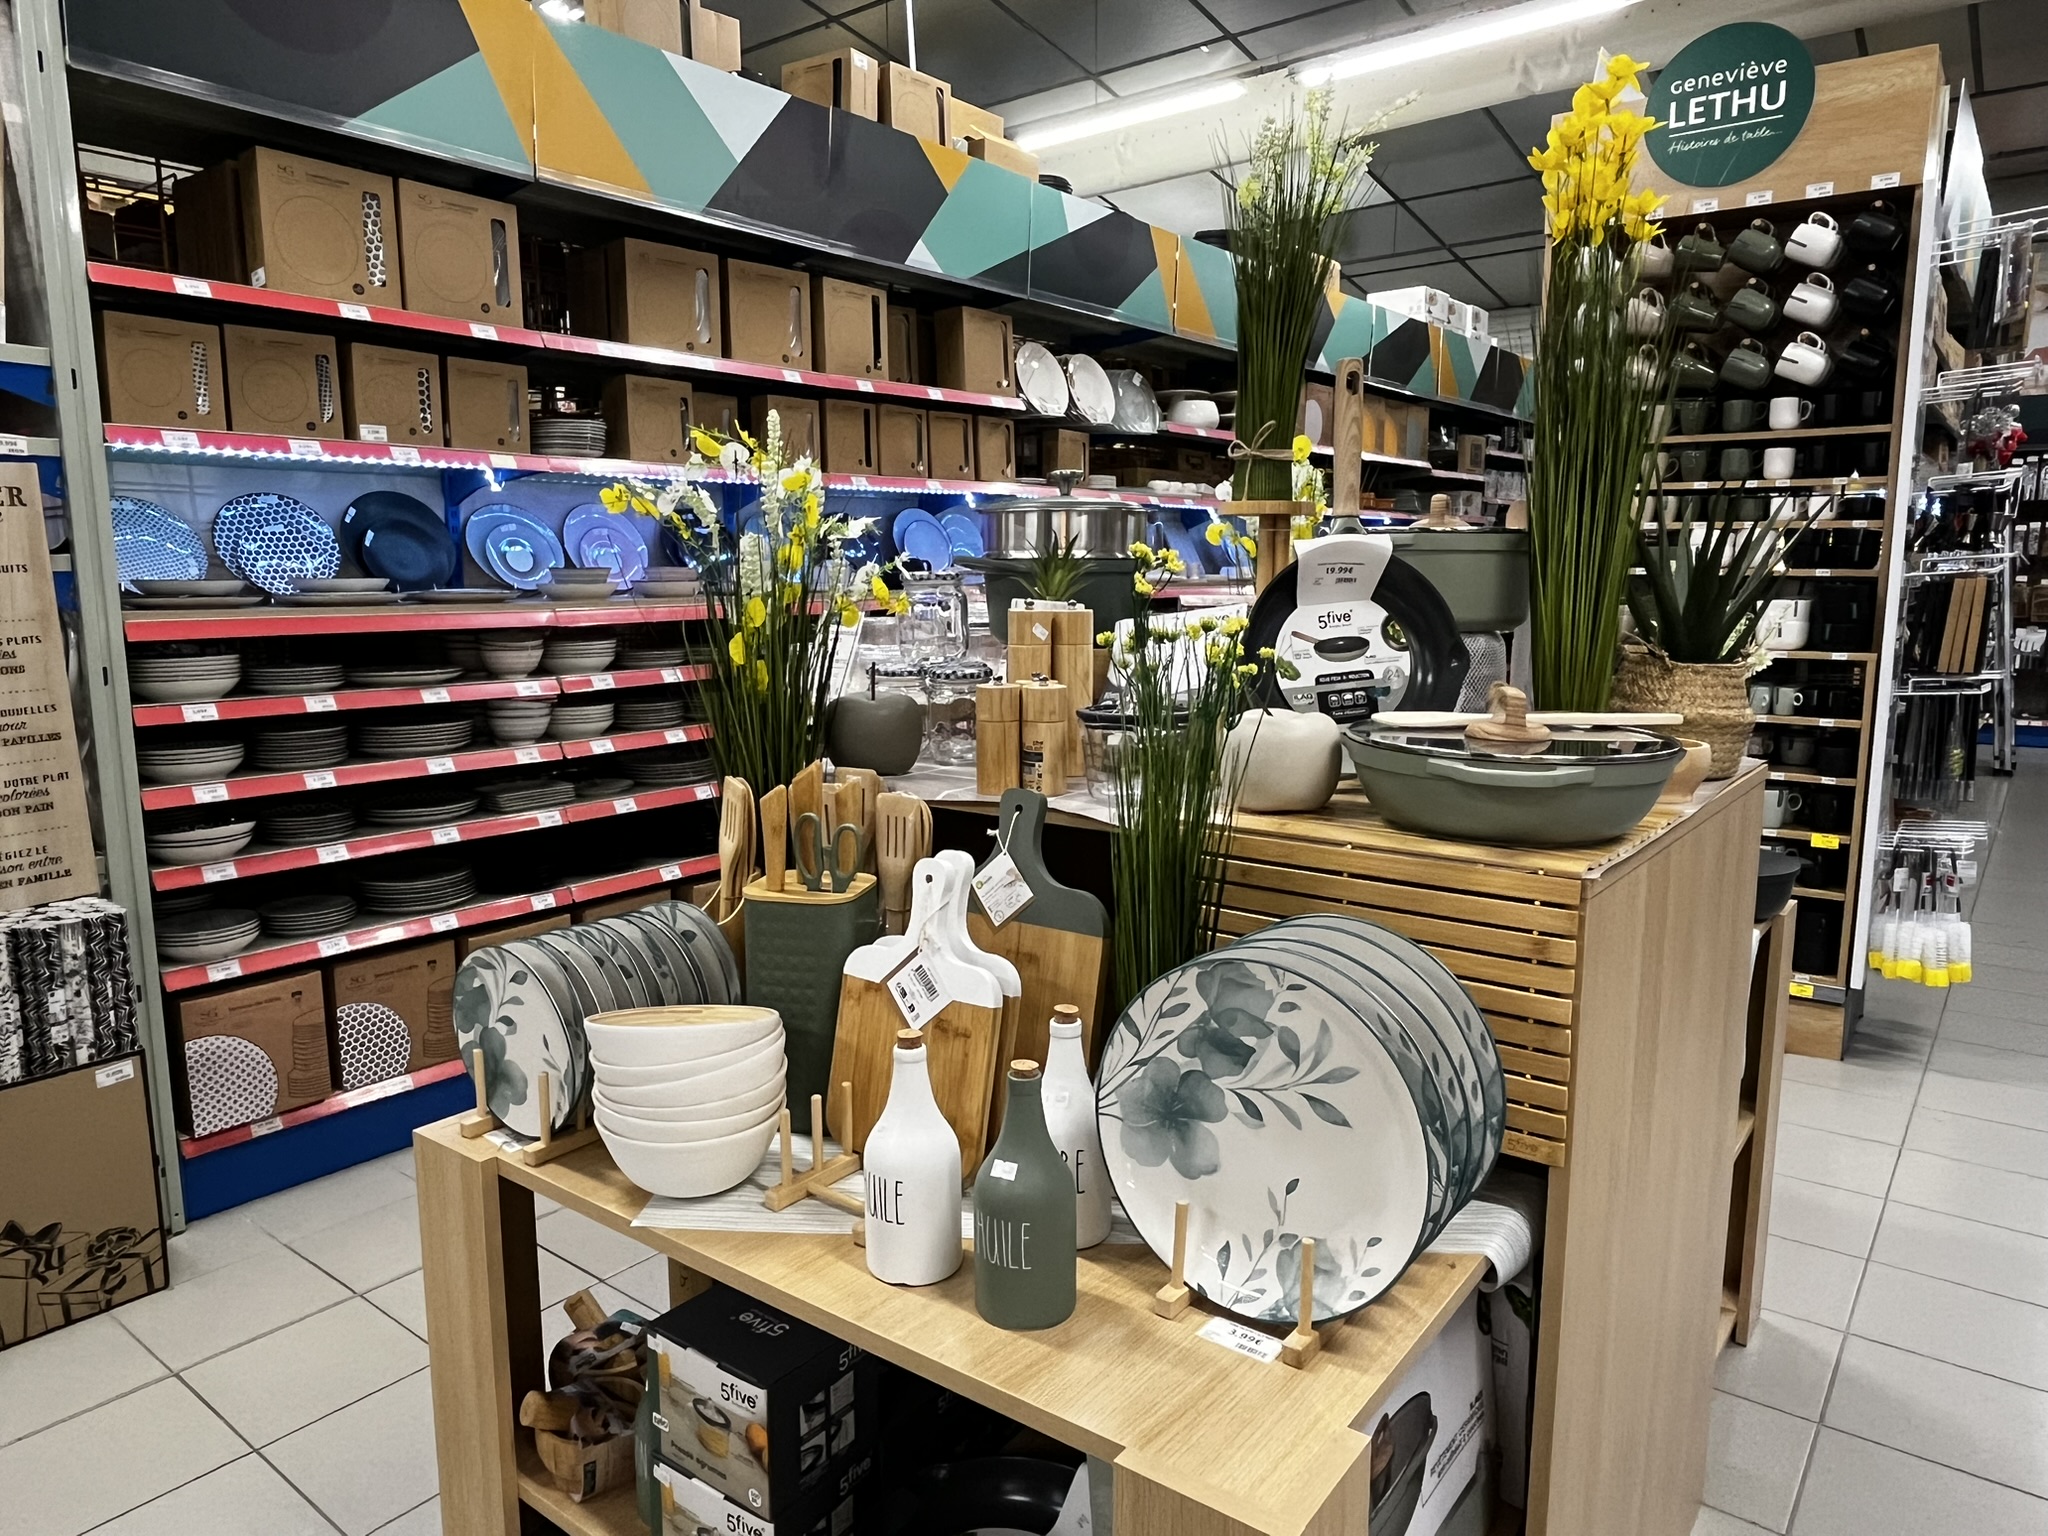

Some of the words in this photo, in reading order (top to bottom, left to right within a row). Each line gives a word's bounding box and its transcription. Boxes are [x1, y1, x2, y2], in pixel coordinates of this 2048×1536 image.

[1668, 80, 1787, 129] LETHU
[1668, 137, 1720, 155] Histoires
[1723, 131, 1739, 144] de
[6, 635, 42, 646] PLATS
[4, 776, 39, 789] VOTRE
[43, 771, 70, 783] PLAT
[25, 802, 55, 814] PAIN
[36, 845, 49, 855] LE
[28, 855, 63, 870] entre
[18, 868, 73, 887] FAMILLE
[867, 1171, 905, 1225] UILE
[976, 1208, 1032, 1270] HUILE
